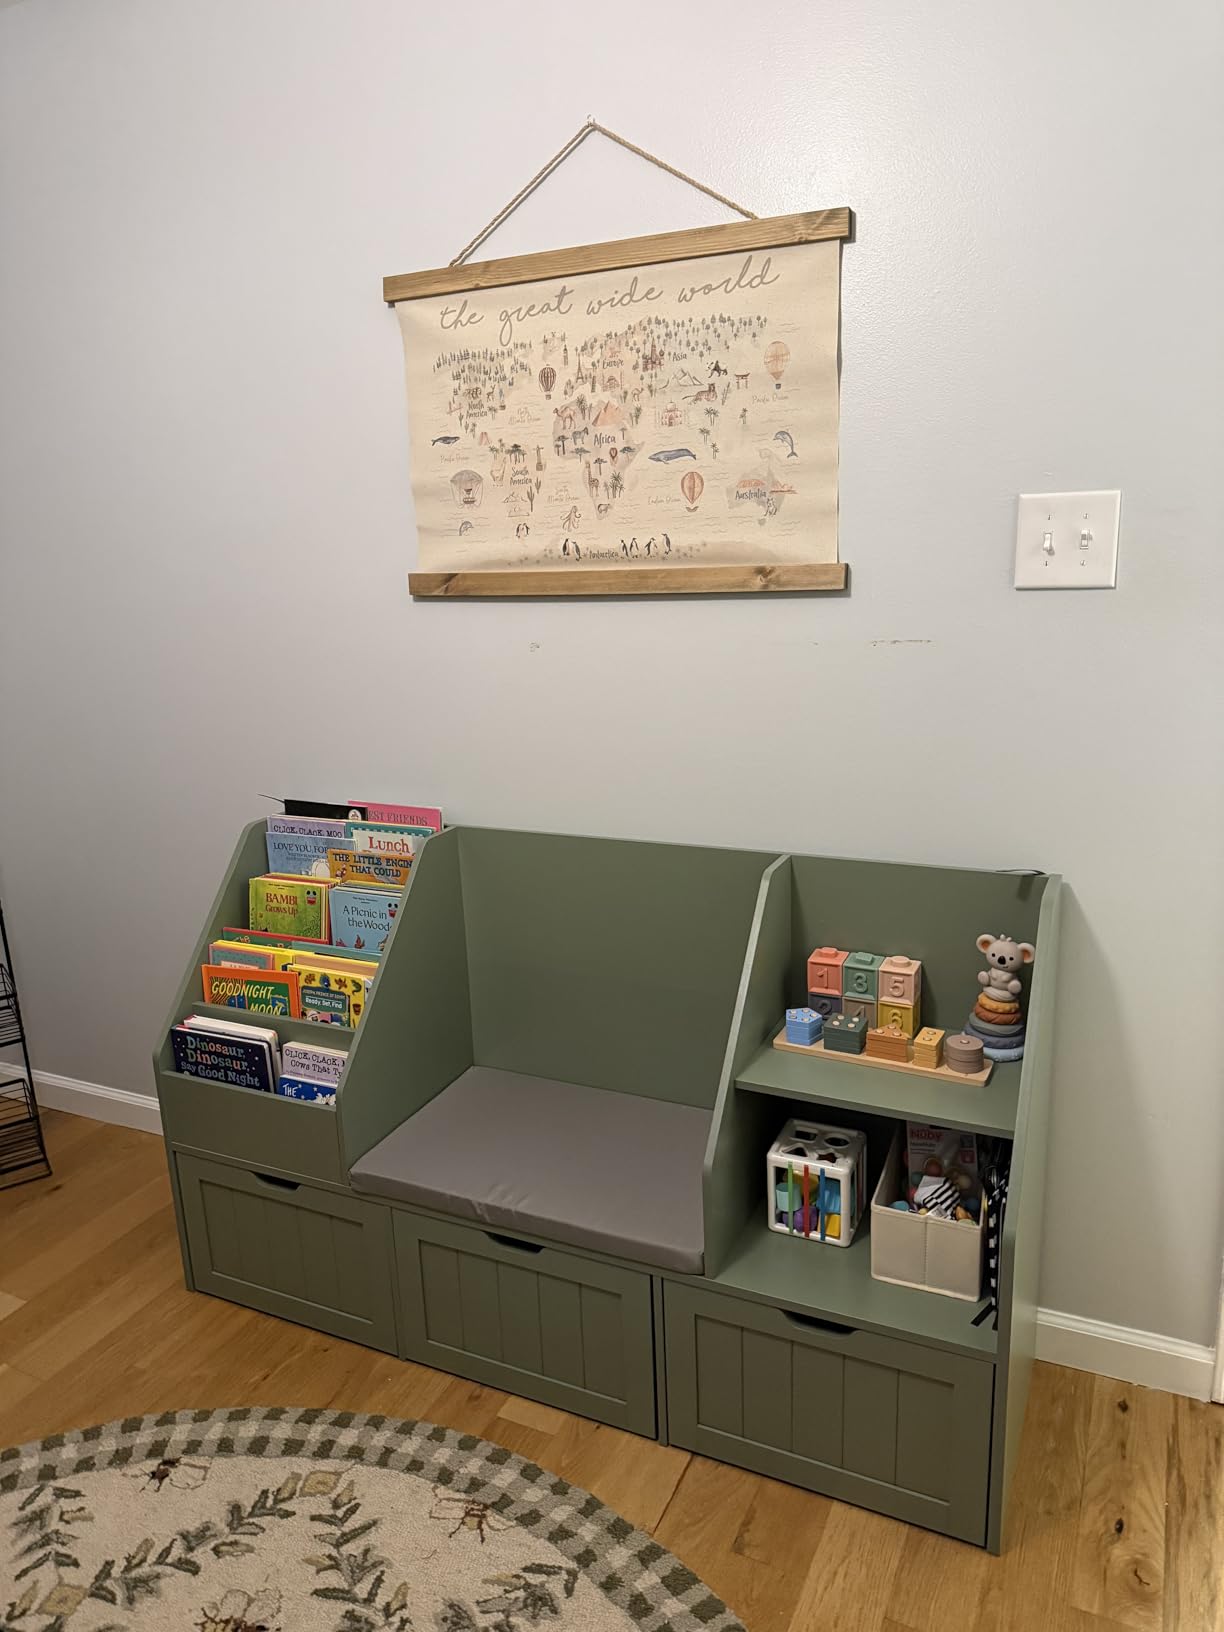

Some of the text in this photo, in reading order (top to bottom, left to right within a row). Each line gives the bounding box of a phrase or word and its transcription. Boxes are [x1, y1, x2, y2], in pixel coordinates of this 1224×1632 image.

[440, 255, 780, 346] the great wide world
[602, 357, 624, 369] Europe
[672, 352, 687, 362] Asia
[593, 432, 616, 448] Africa
[735, 488, 767, 500] Australia
[368, 810, 428, 826] EST FRIENDS
[273, 842, 293, 850] LOVE
[368, 836, 410, 853] Lunch
[333, 853, 350, 863] THE
[353, 855, 382, 866] LITTLE
[350, 865, 401, 878] THAT COULD
[265, 892, 298, 906] BAMBI
[343, 905, 387, 919] A Picnic in
[347, 917, 363, 927] the
[817, 968, 829, 989] 1
[854, 972, 868, 993] 3
[211, 981, 274, 999] GOODNIGHT
[889, 976, 905, 997] 5
[250, 1003, 282, 1015] MOON
[186, 1035, 246, 1059] Dinosaur,
[186, 1049, 250, 1072] Dinosaur,
[197, 1064, 226, 1081] Good
[226, 1070, 260, 1086] Night
[282, 1083, 299, 1097] THE
